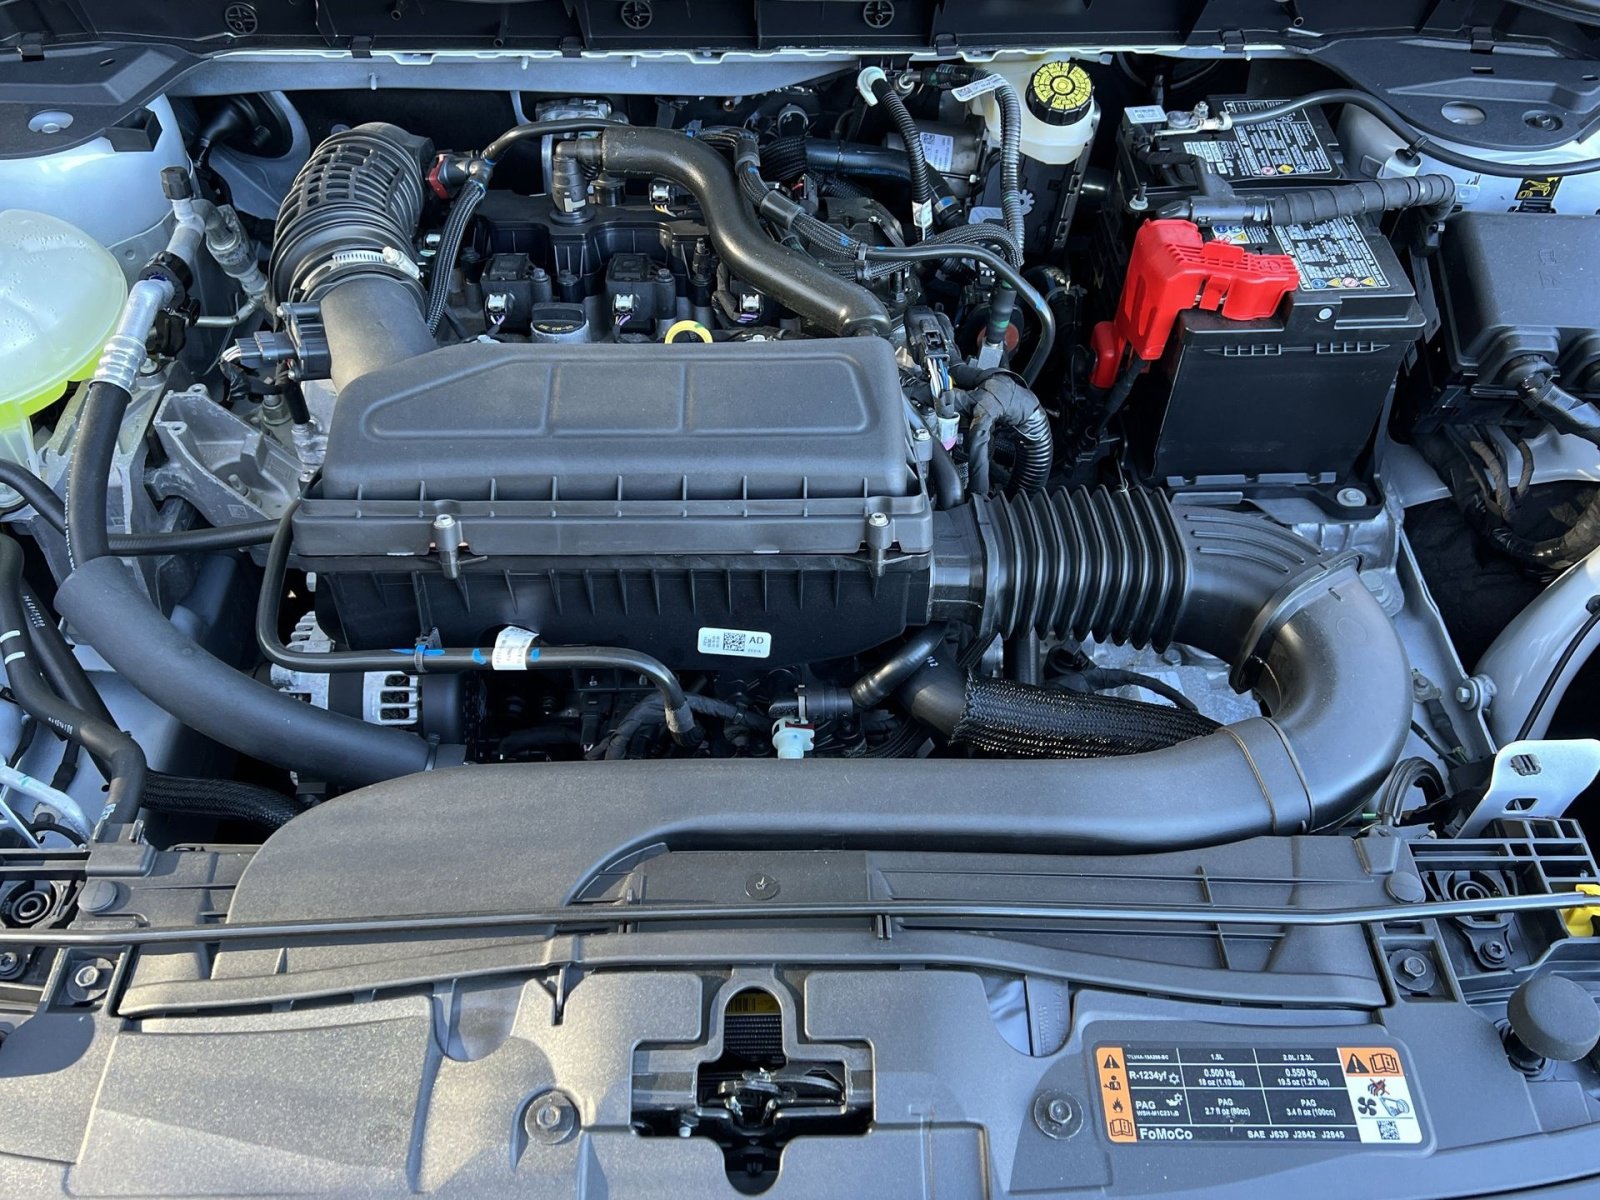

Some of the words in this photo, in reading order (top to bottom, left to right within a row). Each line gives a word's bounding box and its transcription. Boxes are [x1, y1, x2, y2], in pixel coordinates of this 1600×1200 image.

[748, 636, 764, 645] AD
[1128, 1070, 1167, 1082] R-1234yf
[1203, 1068, 1225, 1078] 0.500
[1225, 1068, 1236, 1079] kg
[1284, 1068, 1306, 1078] 0.550
[1306, 1068, 1318, 1079] kg
[1135, 1100, 1156, 1110] PAG
[1217, 1098, 1234, 1106] PAG
[1300, 1098, 1317, 1107] PAG
[1139, 1127, 1193, 1140] FoMoCo
[1247, 1130, 1266, 1139] SAE
[1269, 1130, 1289, 1139] J639
[1293, 1130, 1317, 1139] J2842
[1321, 1130, 1345, 1139] J2845
